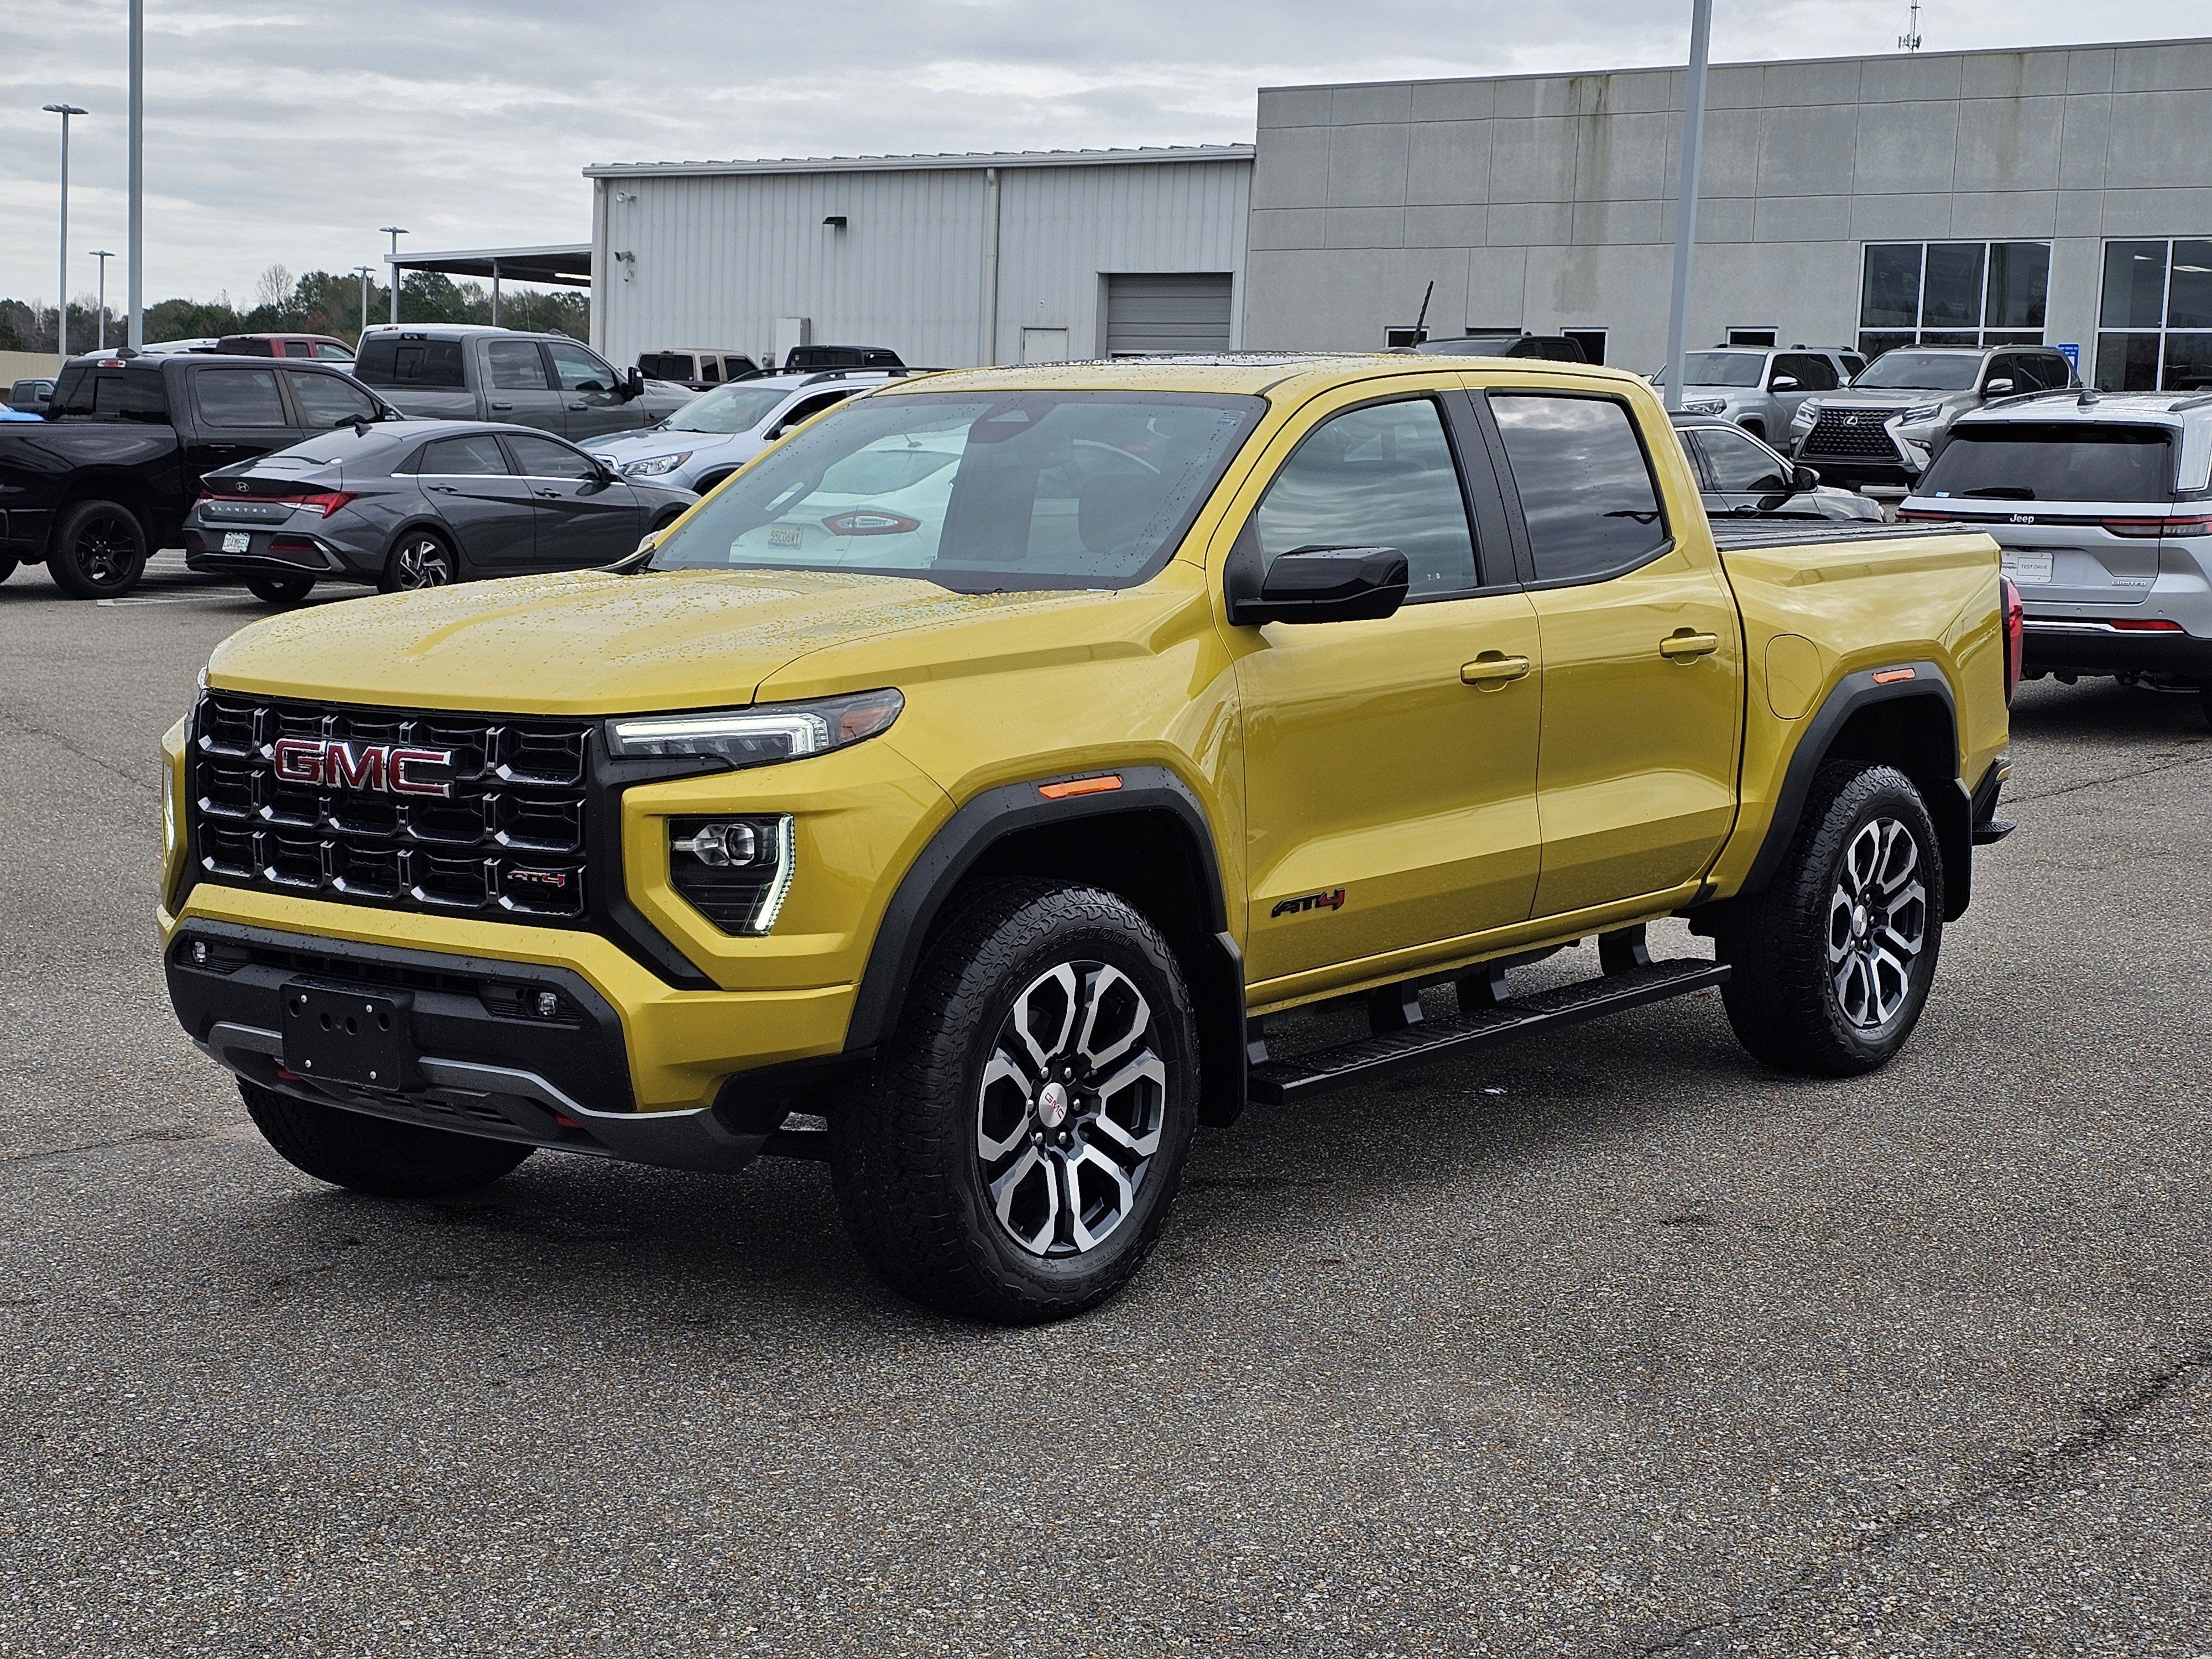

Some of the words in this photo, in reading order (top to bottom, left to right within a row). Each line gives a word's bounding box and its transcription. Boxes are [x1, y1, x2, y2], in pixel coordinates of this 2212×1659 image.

[2010, 513, 2035, 524] Jeep
[275, 738, 452, 799] GMC
[507, 870, 566, 888] AT4
[1271, 887, 1345, 918] AT4
[1045, 1092, 1065, 1119] GMC
